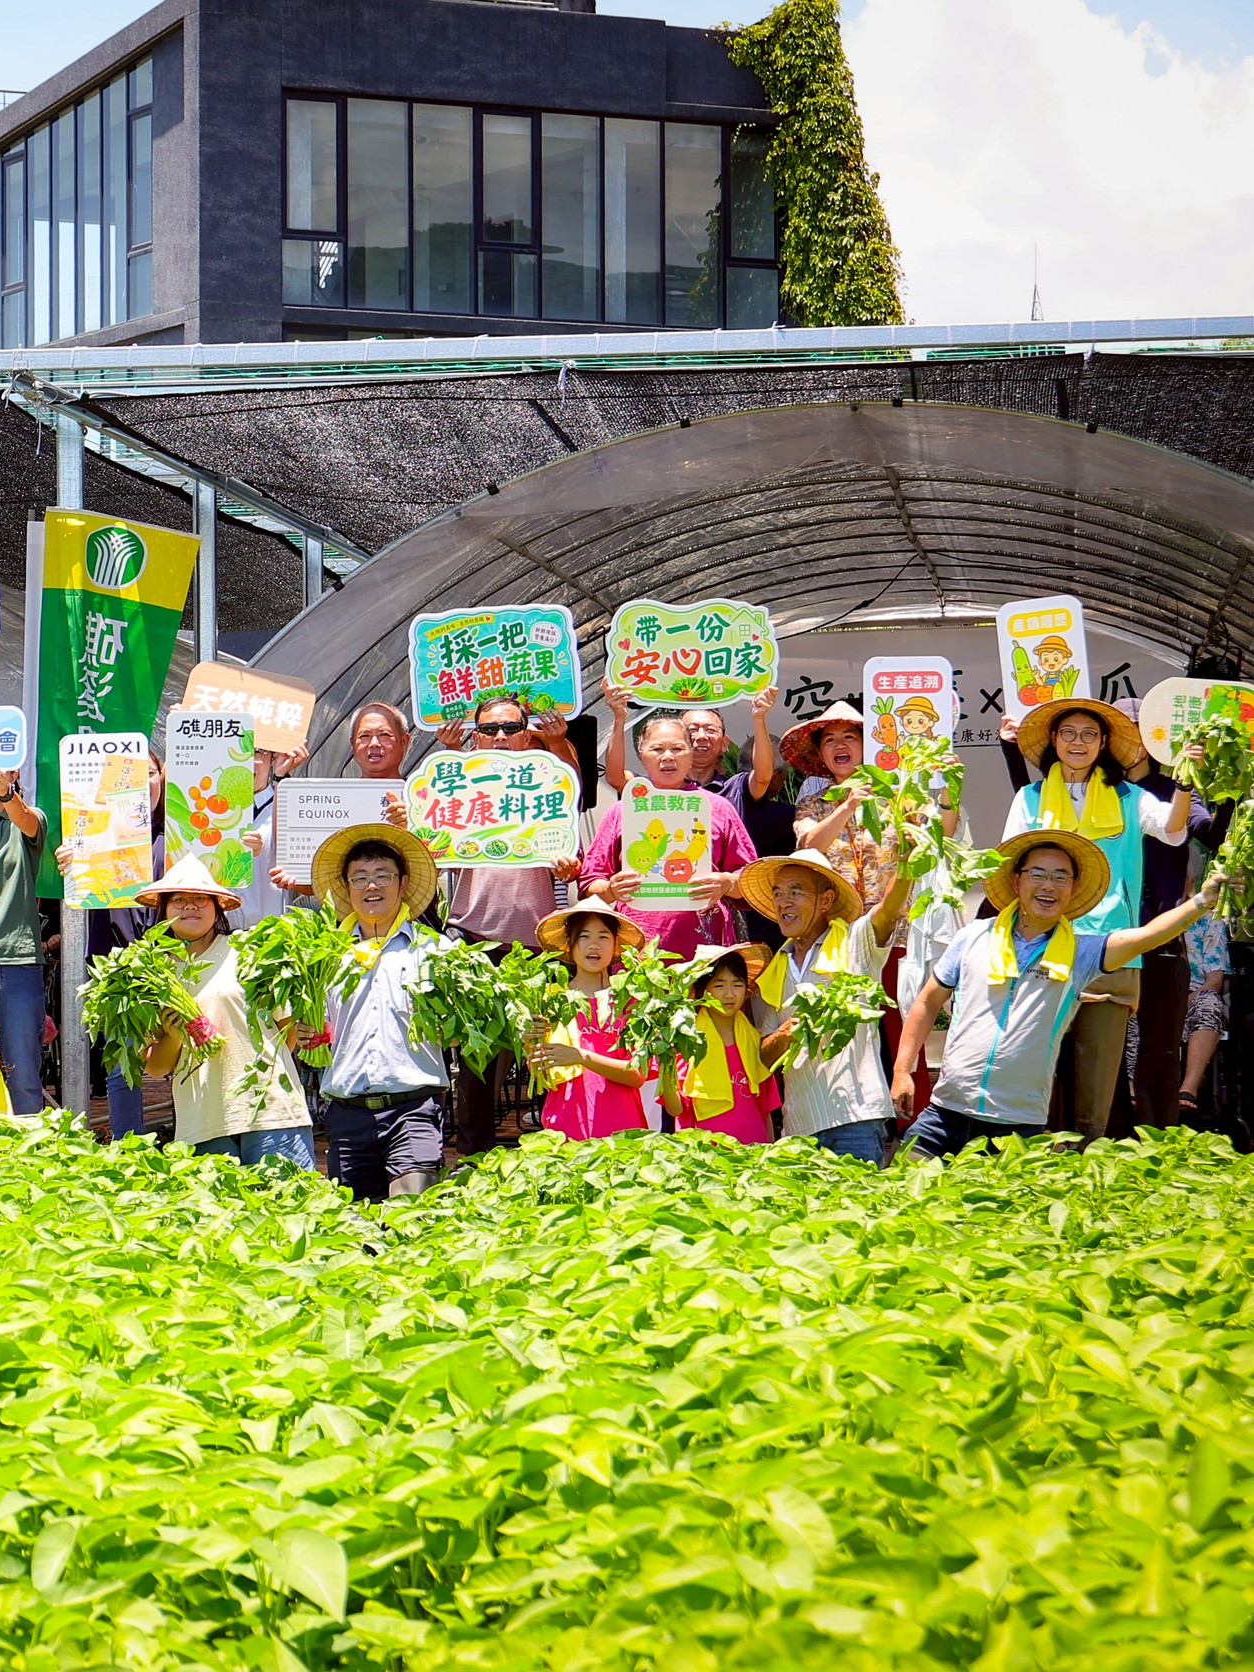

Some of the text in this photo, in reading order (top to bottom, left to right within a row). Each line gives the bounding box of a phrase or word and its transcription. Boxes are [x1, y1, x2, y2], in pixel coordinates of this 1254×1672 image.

[440, 622, 528, 668] 採一把
[635, 613, 731, 648] 帶一份
[438, 650, 559, 704] 鮮甜蔬果
[620, 642, 768, 686] 安心回家
[878, 675, 939, 690] 生產追溯
[193, 684, 304, 731] 天然純粹
[176, 718, 245, 738] 礁朋友
[68, 741, 141, 755] JIAOXI
[430, 761, 543, 797] 學一道
[298, 795, 341, 804] SPRING
[298, 809, 350, 820] EQUINOX
[424, 790, 569, 831] 健康料理
[633, 795, 702, 812] 食農教育
